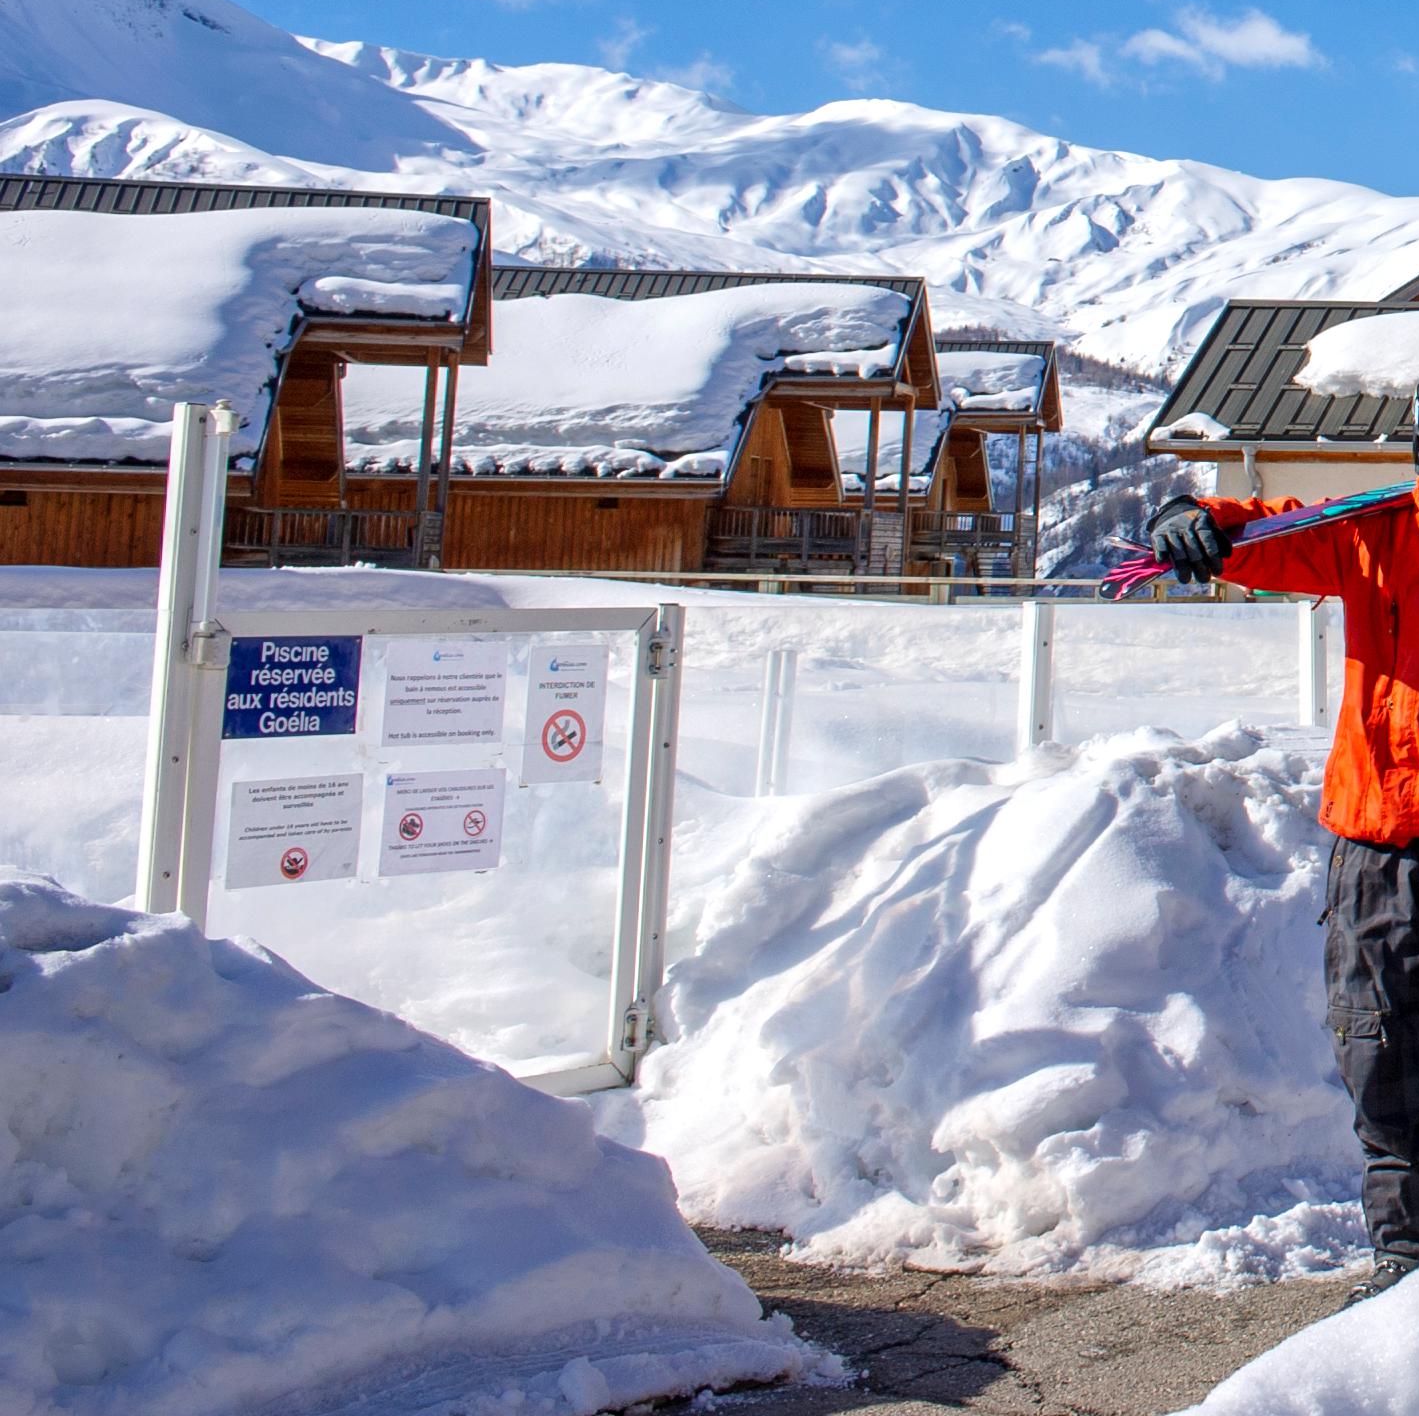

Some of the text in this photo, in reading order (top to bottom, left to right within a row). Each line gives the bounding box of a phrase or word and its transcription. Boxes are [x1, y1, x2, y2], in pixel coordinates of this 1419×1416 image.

[261, 642, 330, 662] Piscine
[250, 664, 336, 685] réservée
[227, 687, 356, 710] aux résidents
[259, 711, 320, 733] Goélia
